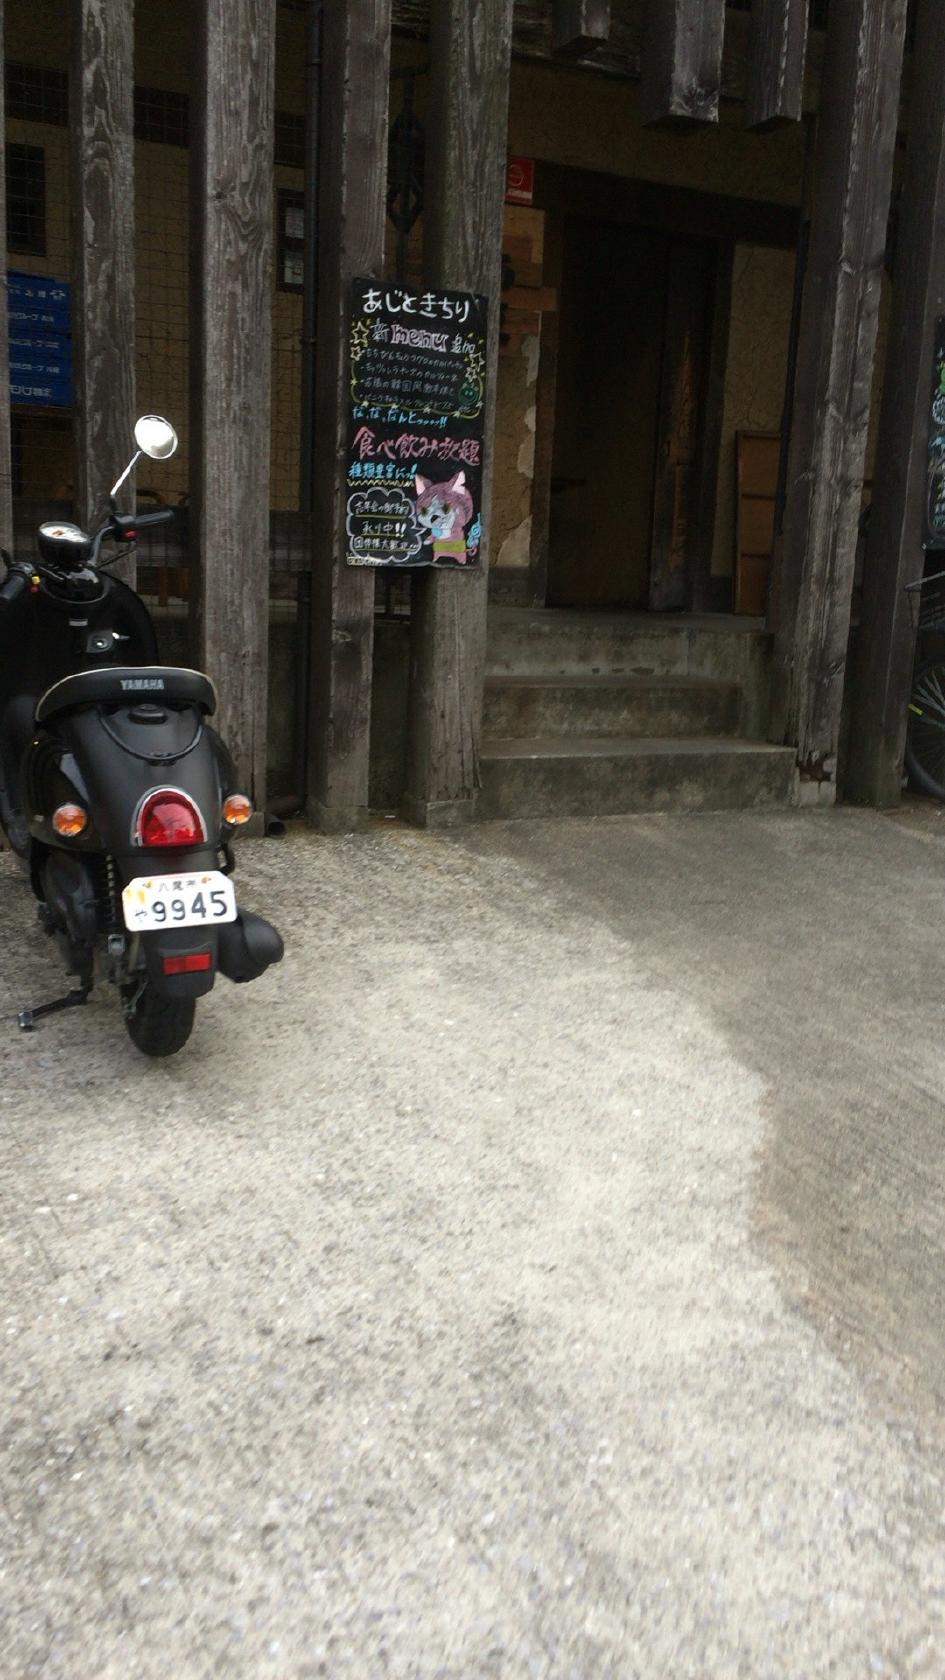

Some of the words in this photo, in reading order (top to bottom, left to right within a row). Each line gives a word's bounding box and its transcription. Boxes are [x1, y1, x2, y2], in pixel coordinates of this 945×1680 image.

[361, 288, 470, 323] あじときちり
[390, 324, 450, 352] menu
[352, 425, 480, 466] 食べ飲み放題
[120, 678, 165, 691] YAMAHA
[150, 890, 228, 923] 9945
